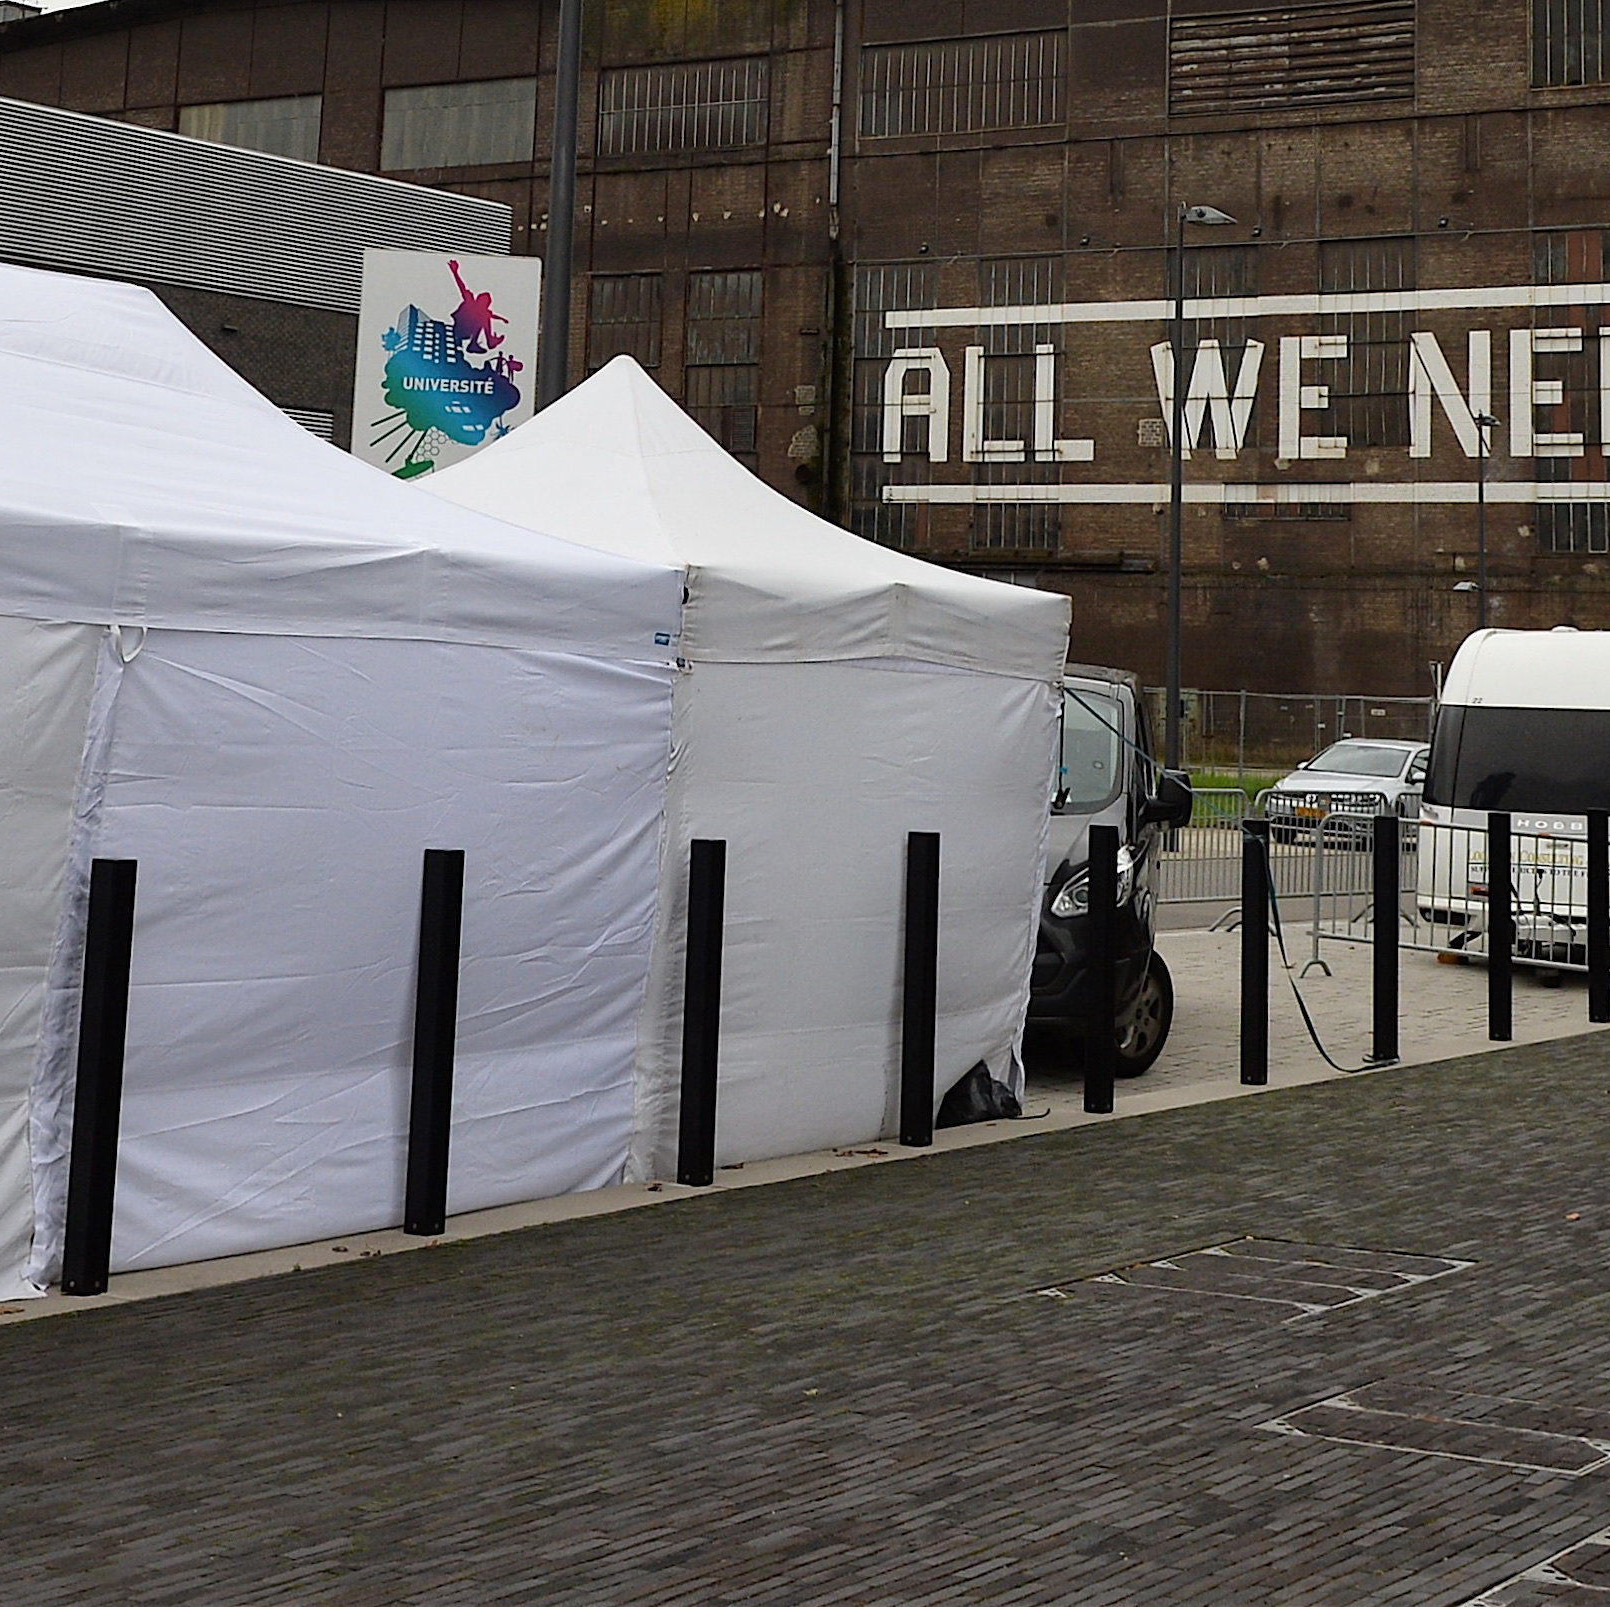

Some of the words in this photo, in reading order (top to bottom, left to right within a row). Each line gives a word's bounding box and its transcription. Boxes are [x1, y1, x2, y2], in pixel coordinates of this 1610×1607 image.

[403, 376, 494, 395] UNIVERSITÉ
[882, 343, 1094, 464] ALL
[1150, 334, 1348, 462] WE
[1516, 818, 1584, 831] HOBB
